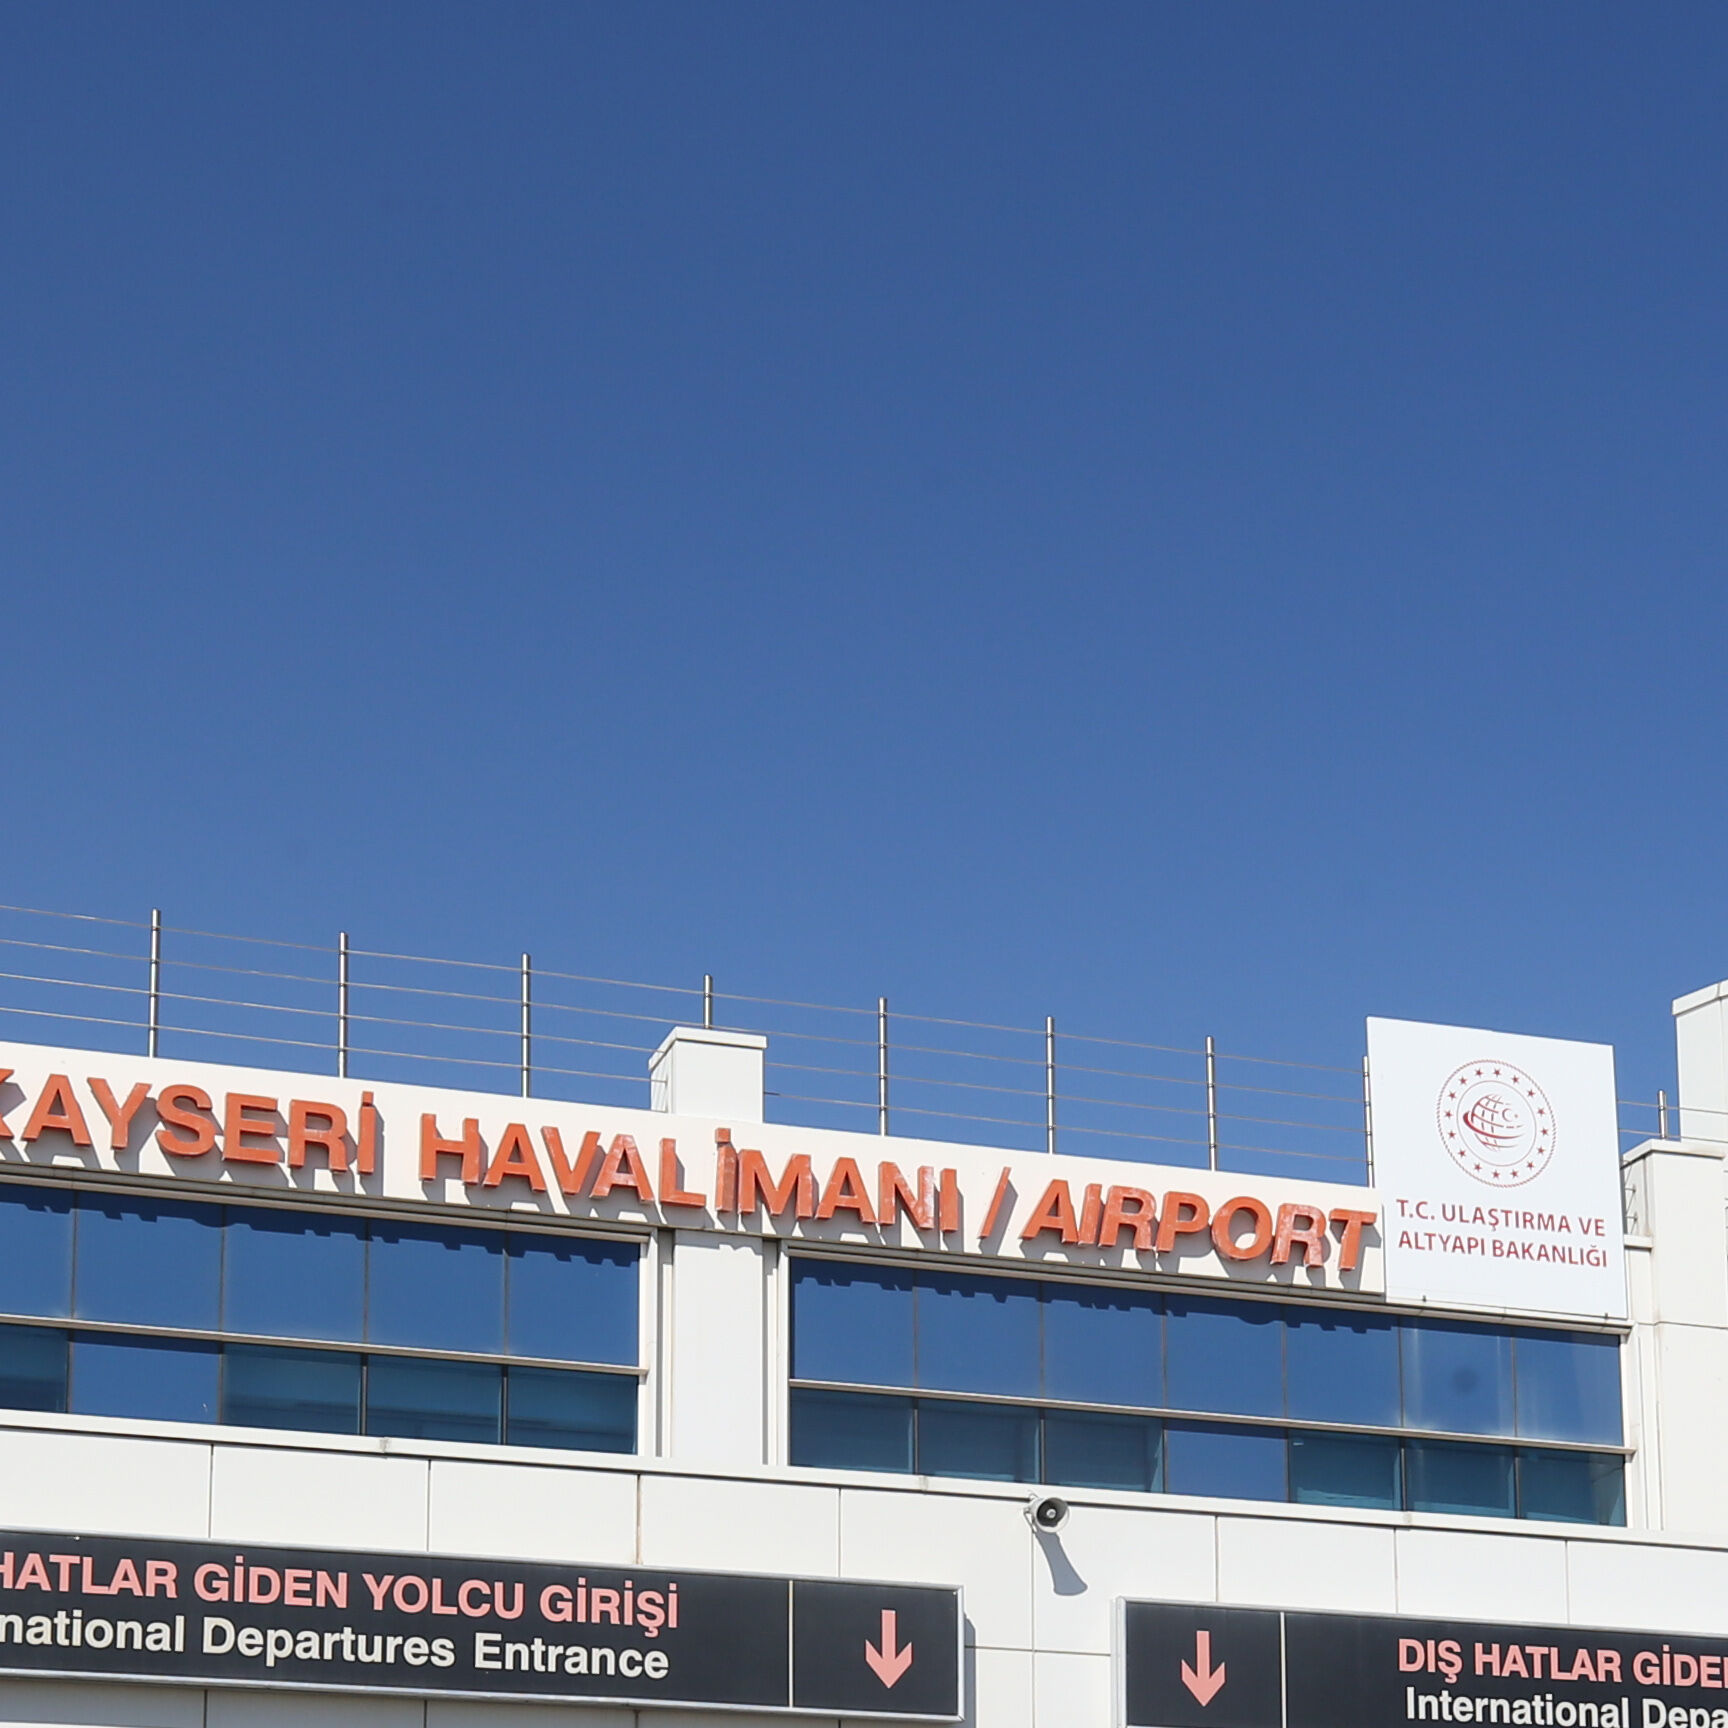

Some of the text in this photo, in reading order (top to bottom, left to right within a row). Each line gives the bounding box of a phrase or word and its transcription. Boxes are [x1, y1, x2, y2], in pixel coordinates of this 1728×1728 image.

[419, 1112, 958, 1232] HAVALİMANI
[977, 1166, 1011, 1239] /
[1019, 1179, 1378, 1271] AIRPORT
[1396, 1199, 1606, 1237] T.C. ULAŞTIRMA VE
[1398, 1231, 1607, 1267] ALTYAPI BAKANLIĞI
[193, 1554, 348, 1609] GİDEN
[362, 1572, 524, 1620] YOLCU
[539, 1577, 679, 1638] GİRİŞİ
[201, 1614, 456, 1668] Departures
[473, 1632, 670, 1680] Entrance
[1397, 1638, 1463, 1684] DIŞ
[1474, 1643, 1623, 1684] HATLAR
[1405, 1686, 1630, 1728] International
